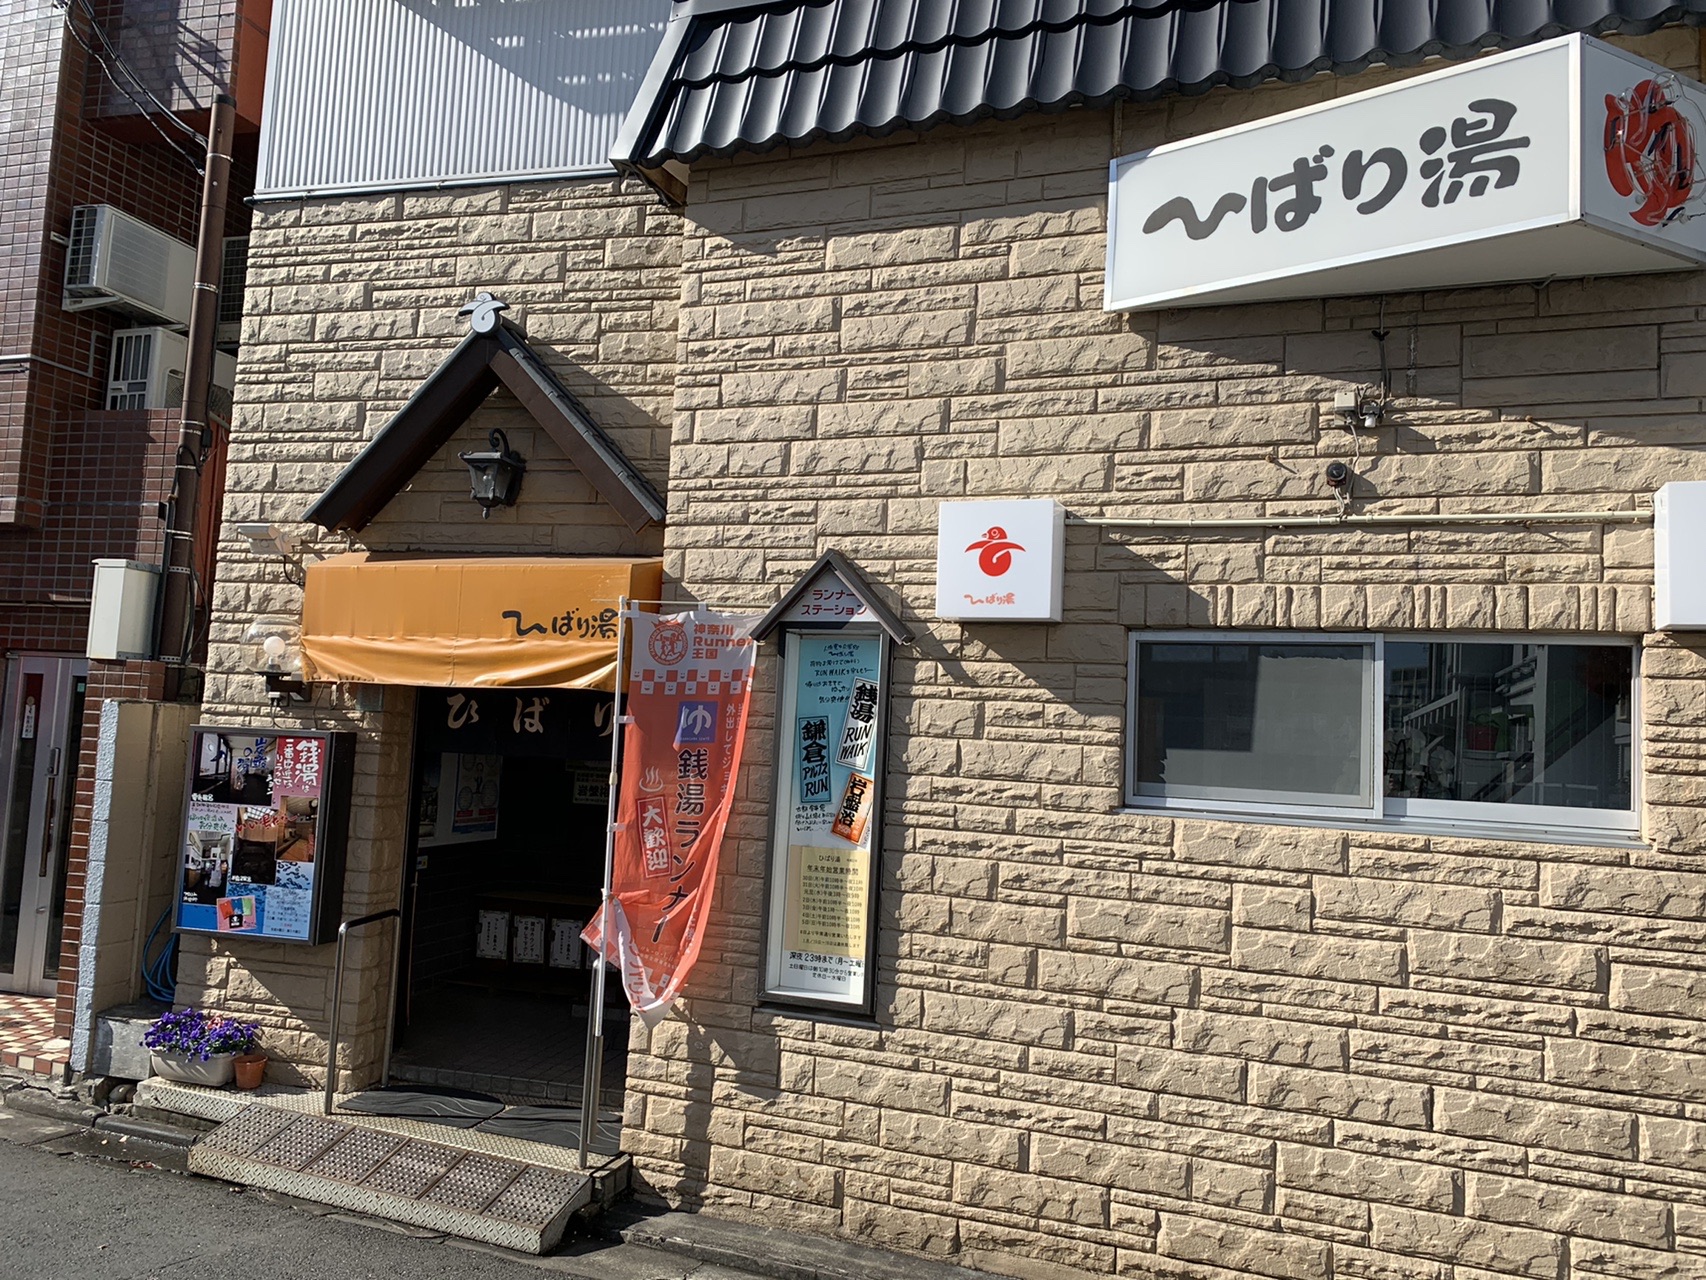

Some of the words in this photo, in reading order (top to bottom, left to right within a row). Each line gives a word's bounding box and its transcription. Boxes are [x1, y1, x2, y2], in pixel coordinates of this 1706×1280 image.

[813, 589, 855, 600] ランナー
[801, 604, 867, 615] ステーション
[693, 623, 734, 636] 神奈川
[693, 636, 753, 647] Runner
[692, 648, 719, 659] 王国
[850, 683, 878, 724] 銭湯
[682, 705, 711, 735] ゆ
[801, 719, 828, 764] 鎌倉
[844, 724, 872, 744] RUN
[805, 776, 829, 797] RUN
[839, 777, 867, 828] 岩盤浴
[642, 805, 668, 870] 大歓迎
[651, 748, 709, 943] 銭湯ランナー
[807, 864, 859, 876] 年末年始営業時間
